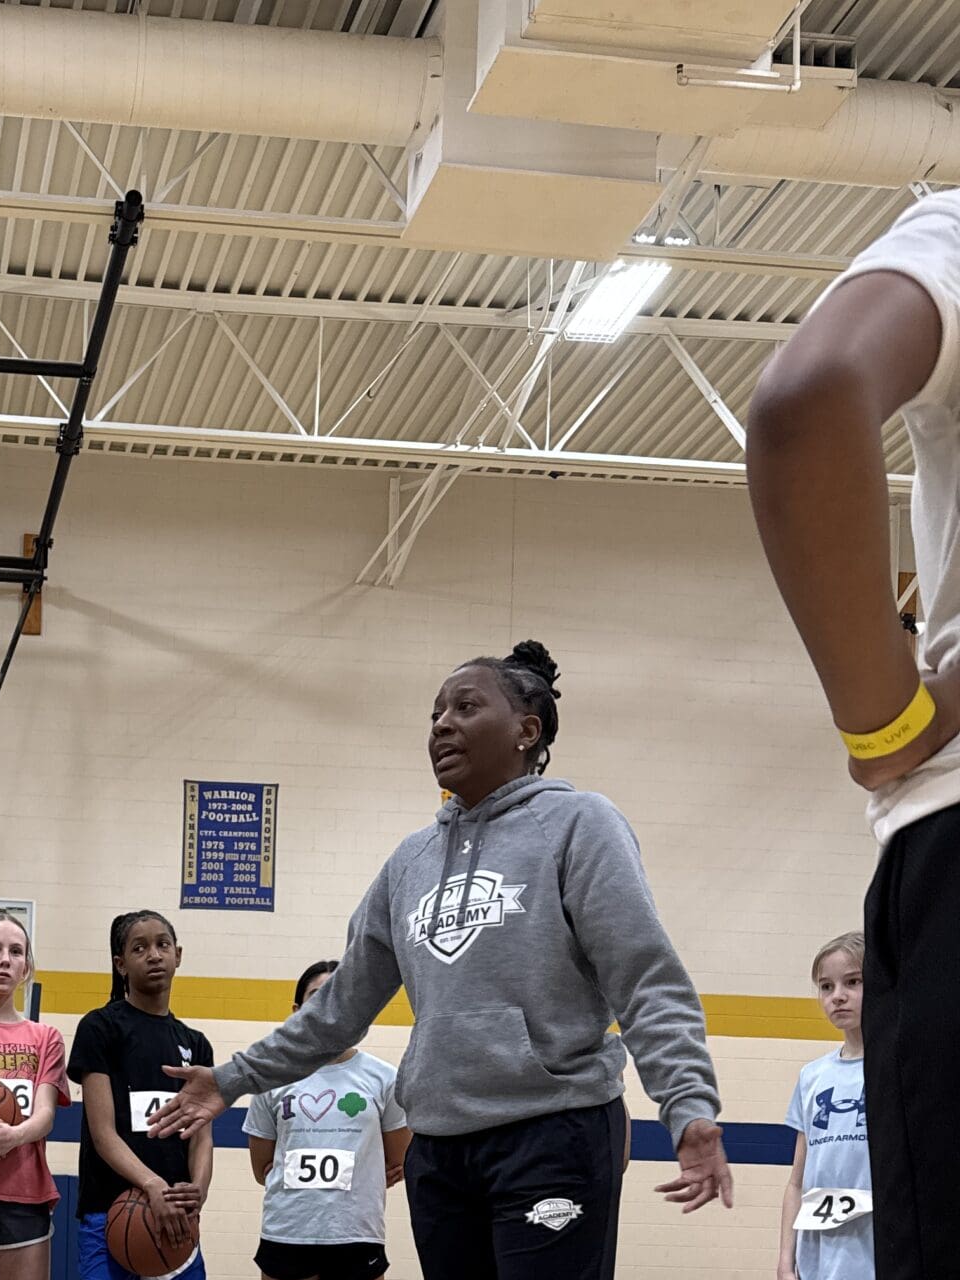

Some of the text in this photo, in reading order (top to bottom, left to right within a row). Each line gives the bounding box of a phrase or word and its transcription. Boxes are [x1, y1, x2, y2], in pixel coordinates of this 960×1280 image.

[203, 790, 256, 802] WARRIOR
[208, 802, 253, 811] 1973-2008
[201, 810, 259, 823] FOOTBALL
[201, 841, 256, 851] 1975 1976
[201, 851, 225, 860] 1999
[201, 862, 256, 871] 2001 2002
[233, 874, 256, 882] 2005
[199, 886, 257, 895] GOD FAMILY
[183, 896, 272, 905] SCHOOL FOOTBALL
[418, 906, 491, 938] AADMY
[13, 1085, 29, 1109] 6
[145, 1097, 173, 1118] 4
[281, 1094, 296, 1121] I
[809, 1134, 867, 1146] UNDER ARMO
[298, 1155, 339, 1182] 50
[813, 1195, 856, 1224] 43
